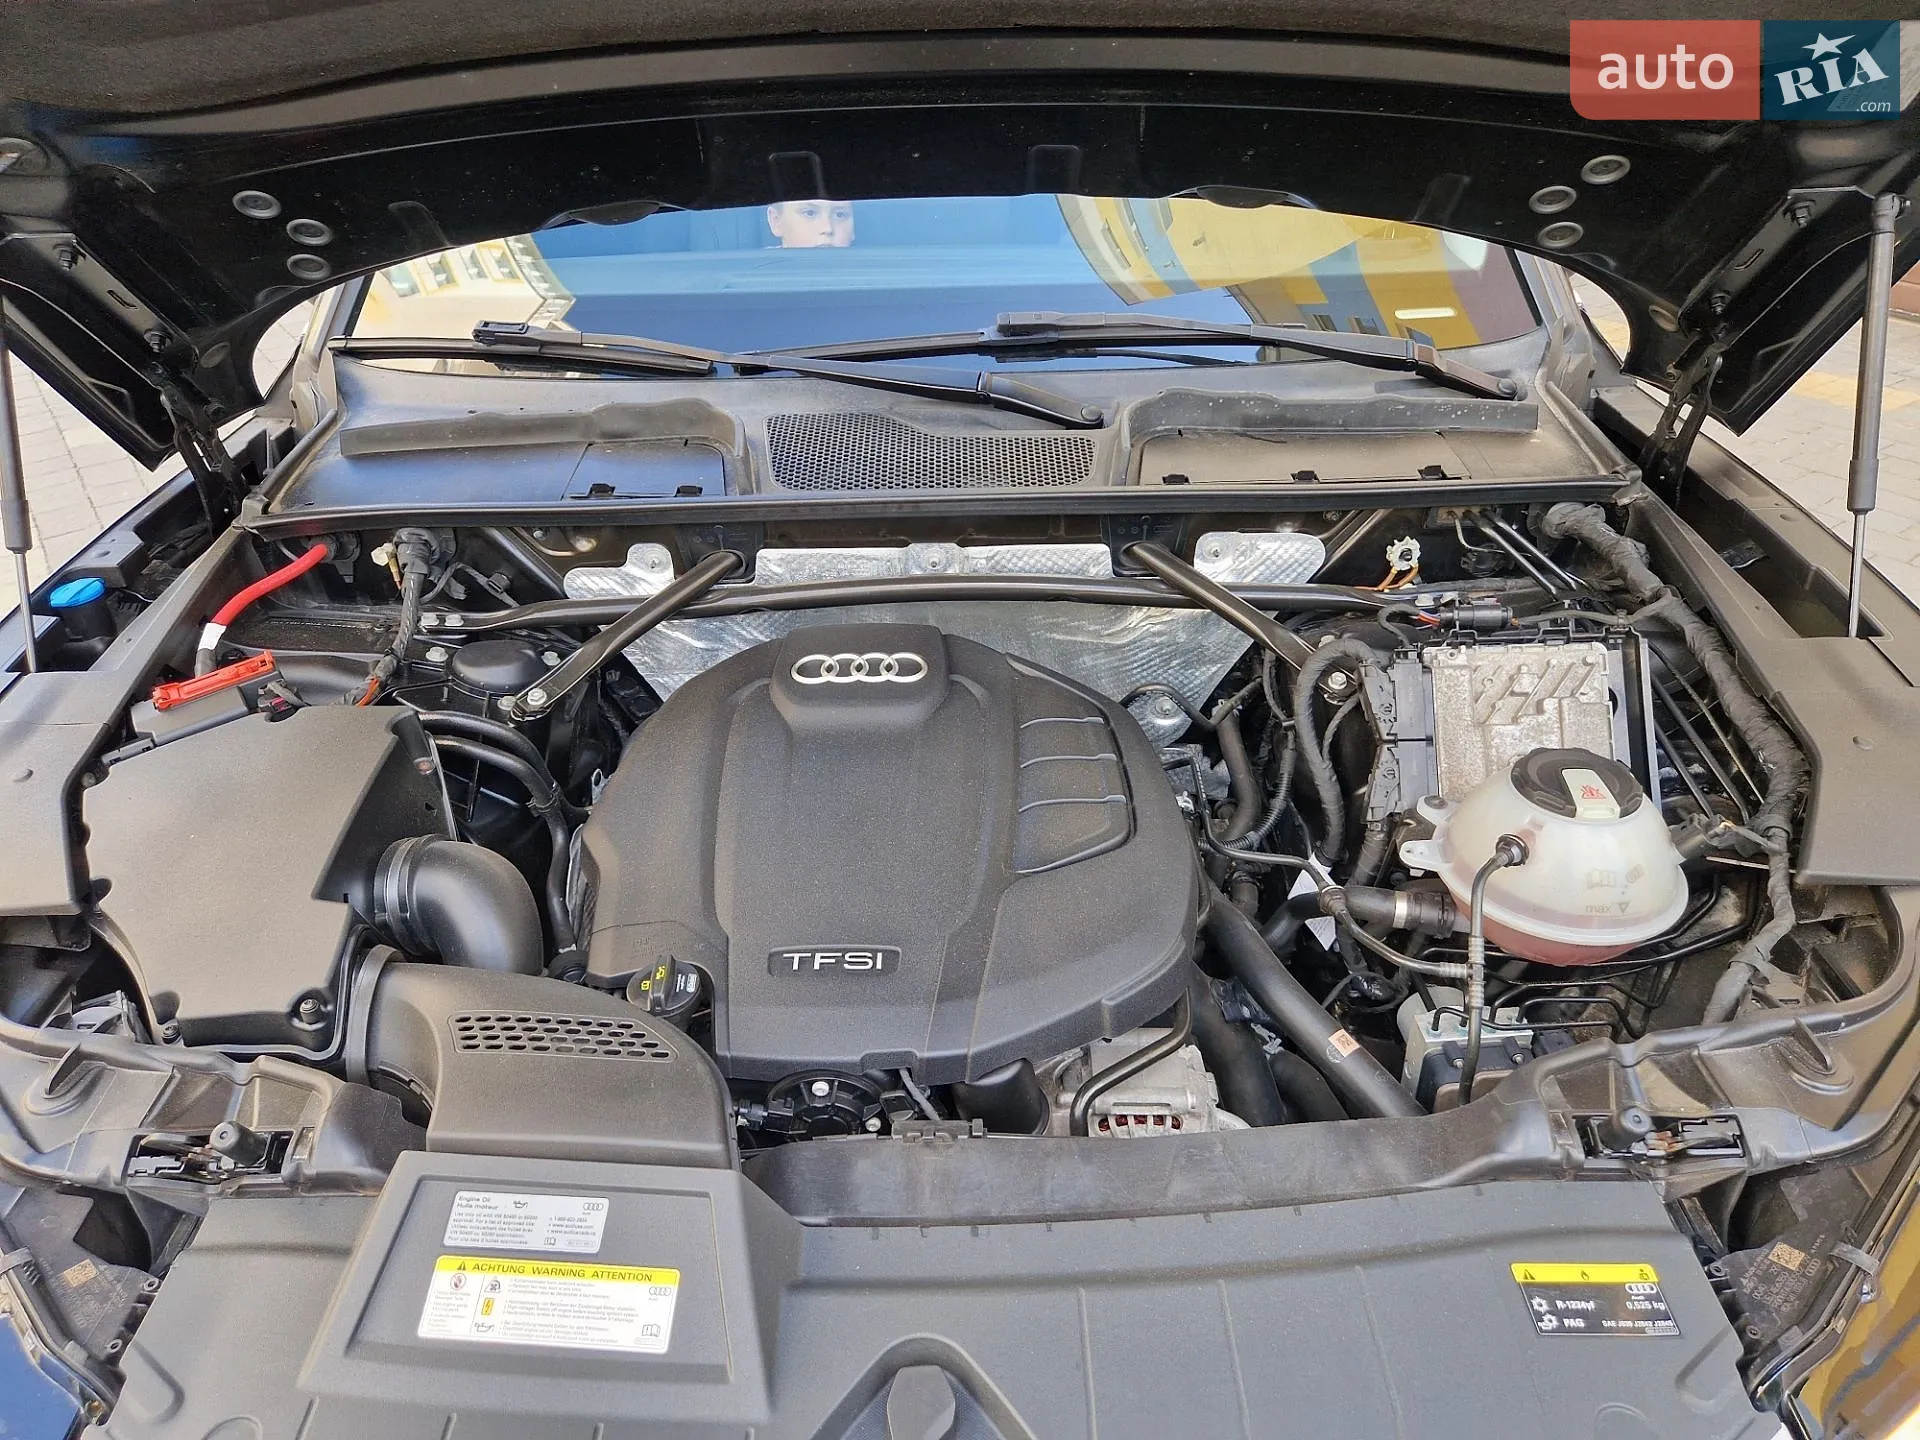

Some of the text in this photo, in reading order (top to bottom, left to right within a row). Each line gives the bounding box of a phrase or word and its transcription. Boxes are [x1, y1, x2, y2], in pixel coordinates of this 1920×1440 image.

[782, 952, 883, 971] TFSI
[472, 1262, 526, 1274] ACHTUNG
[532, 1266, 586, 1279] WARNING
[591, 1270, 654, 1282] ATTENTION
[1562, 1318, 1585, 1328] PAG
